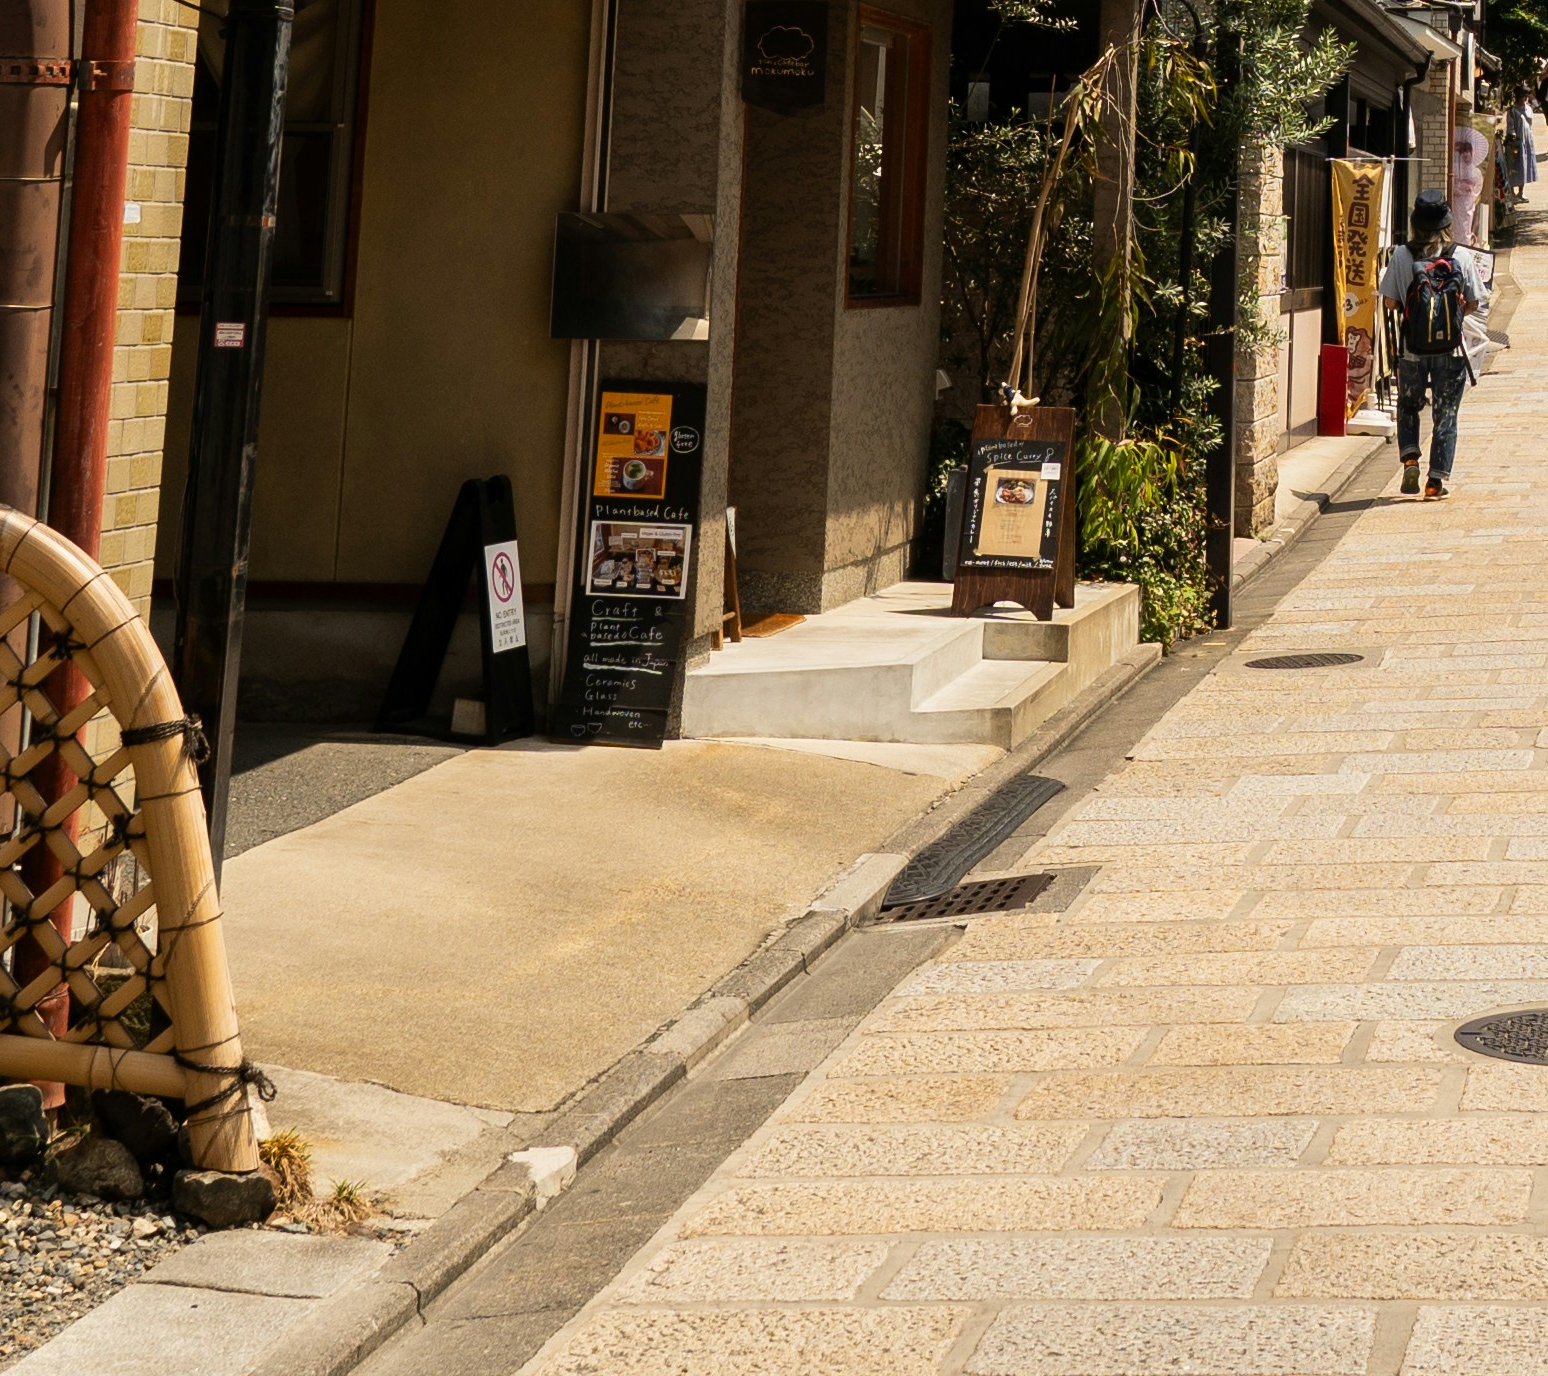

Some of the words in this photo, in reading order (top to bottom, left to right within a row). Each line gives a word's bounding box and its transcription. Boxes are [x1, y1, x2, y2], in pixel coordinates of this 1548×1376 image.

[1345, 173, 1375, 287] 全国発送
[986, 452, 1013, 464] Spice
[1016, 450, 1042, 462] Curry
[663, 506, 690, 520] Cafe
[495, 612, 503, 620] NO
[502, 608, 517, 619] ENTRY
[591, 599, 639, 617] Craft
[654, 606, 663, 617] &
[628, 626, 663, 641] Cafe
[585, 674, 637, 690] Ceramics
[584, 689, 618, 701] Glass
[582, 707, 641, 719] Handwoven
